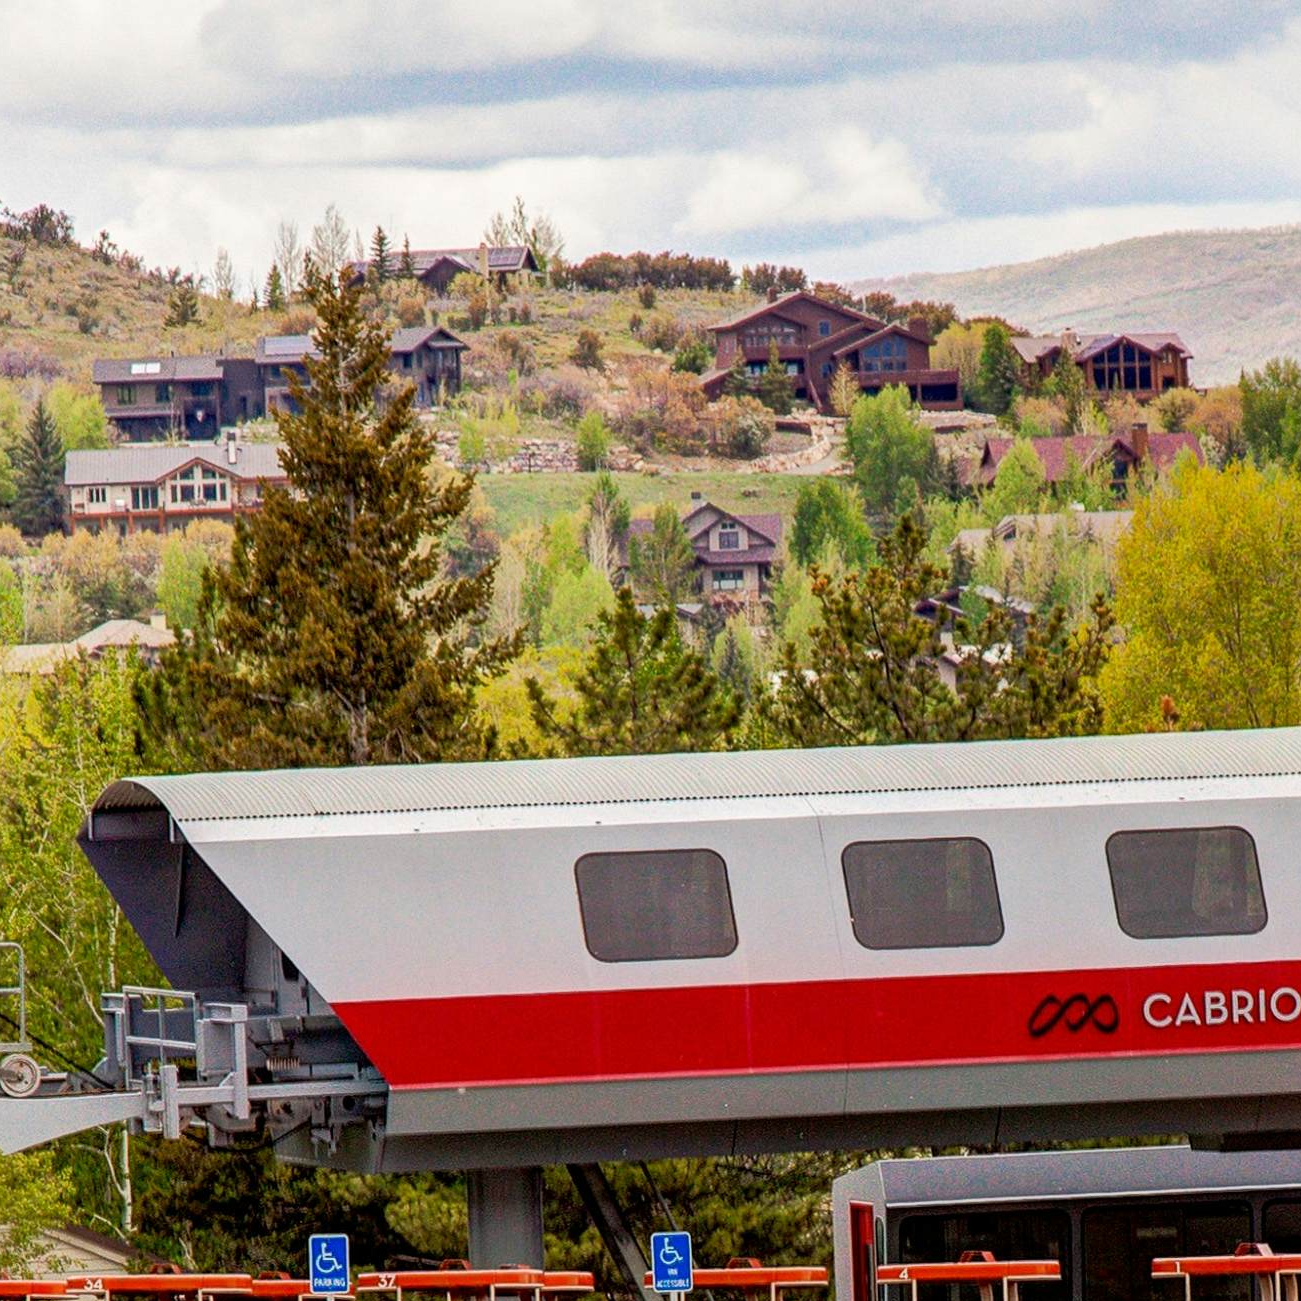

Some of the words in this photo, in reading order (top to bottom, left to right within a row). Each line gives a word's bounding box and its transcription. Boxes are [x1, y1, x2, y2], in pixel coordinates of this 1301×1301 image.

[84, 1278, 104, 1291] 34
[313, 1277, 346, 1288] PARKING
[378, 1274, 396, 1288] 37
